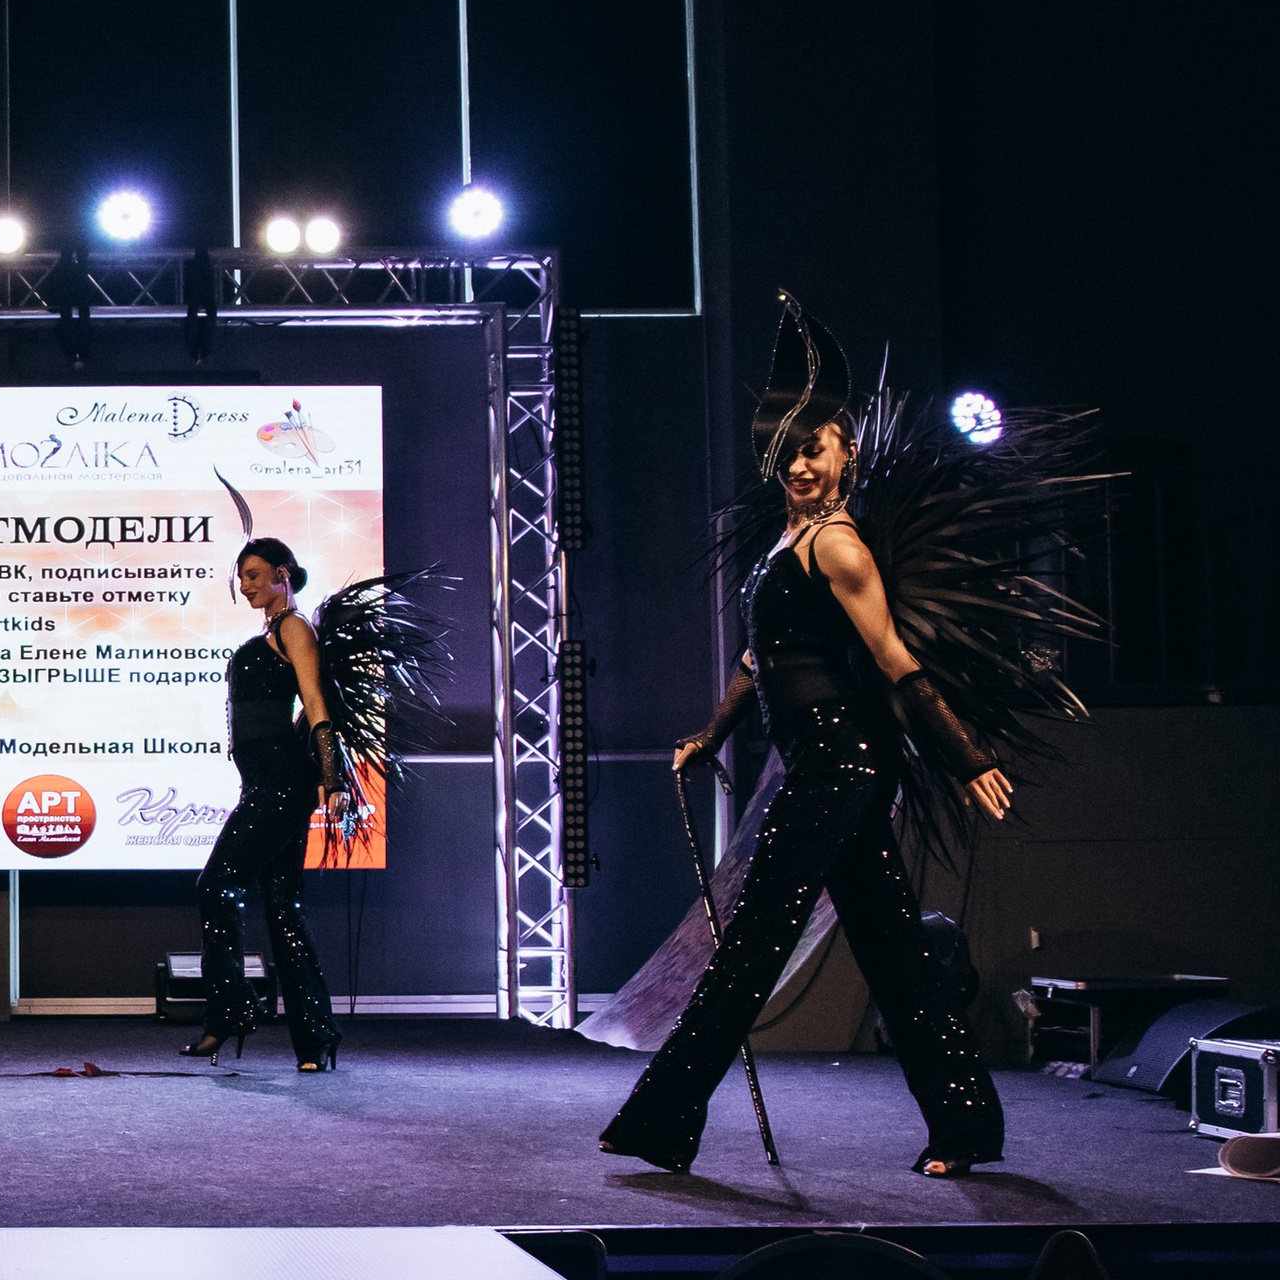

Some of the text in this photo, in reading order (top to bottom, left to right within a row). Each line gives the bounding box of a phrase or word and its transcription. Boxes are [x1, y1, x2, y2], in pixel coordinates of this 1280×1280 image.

[41, 564, 215, 582] подписывайте:
[8, 591, 95, 603] ставьте
[102, 591, 191, 606] отметку
[20, 645, 87, 660] Елене
[96, 645, 234, 660] Малиновско
[129, 671, 228, 686] подарко
[0, 738, 221, 756] Модельная Школа
[17, 791, 82, 814] АРТ
